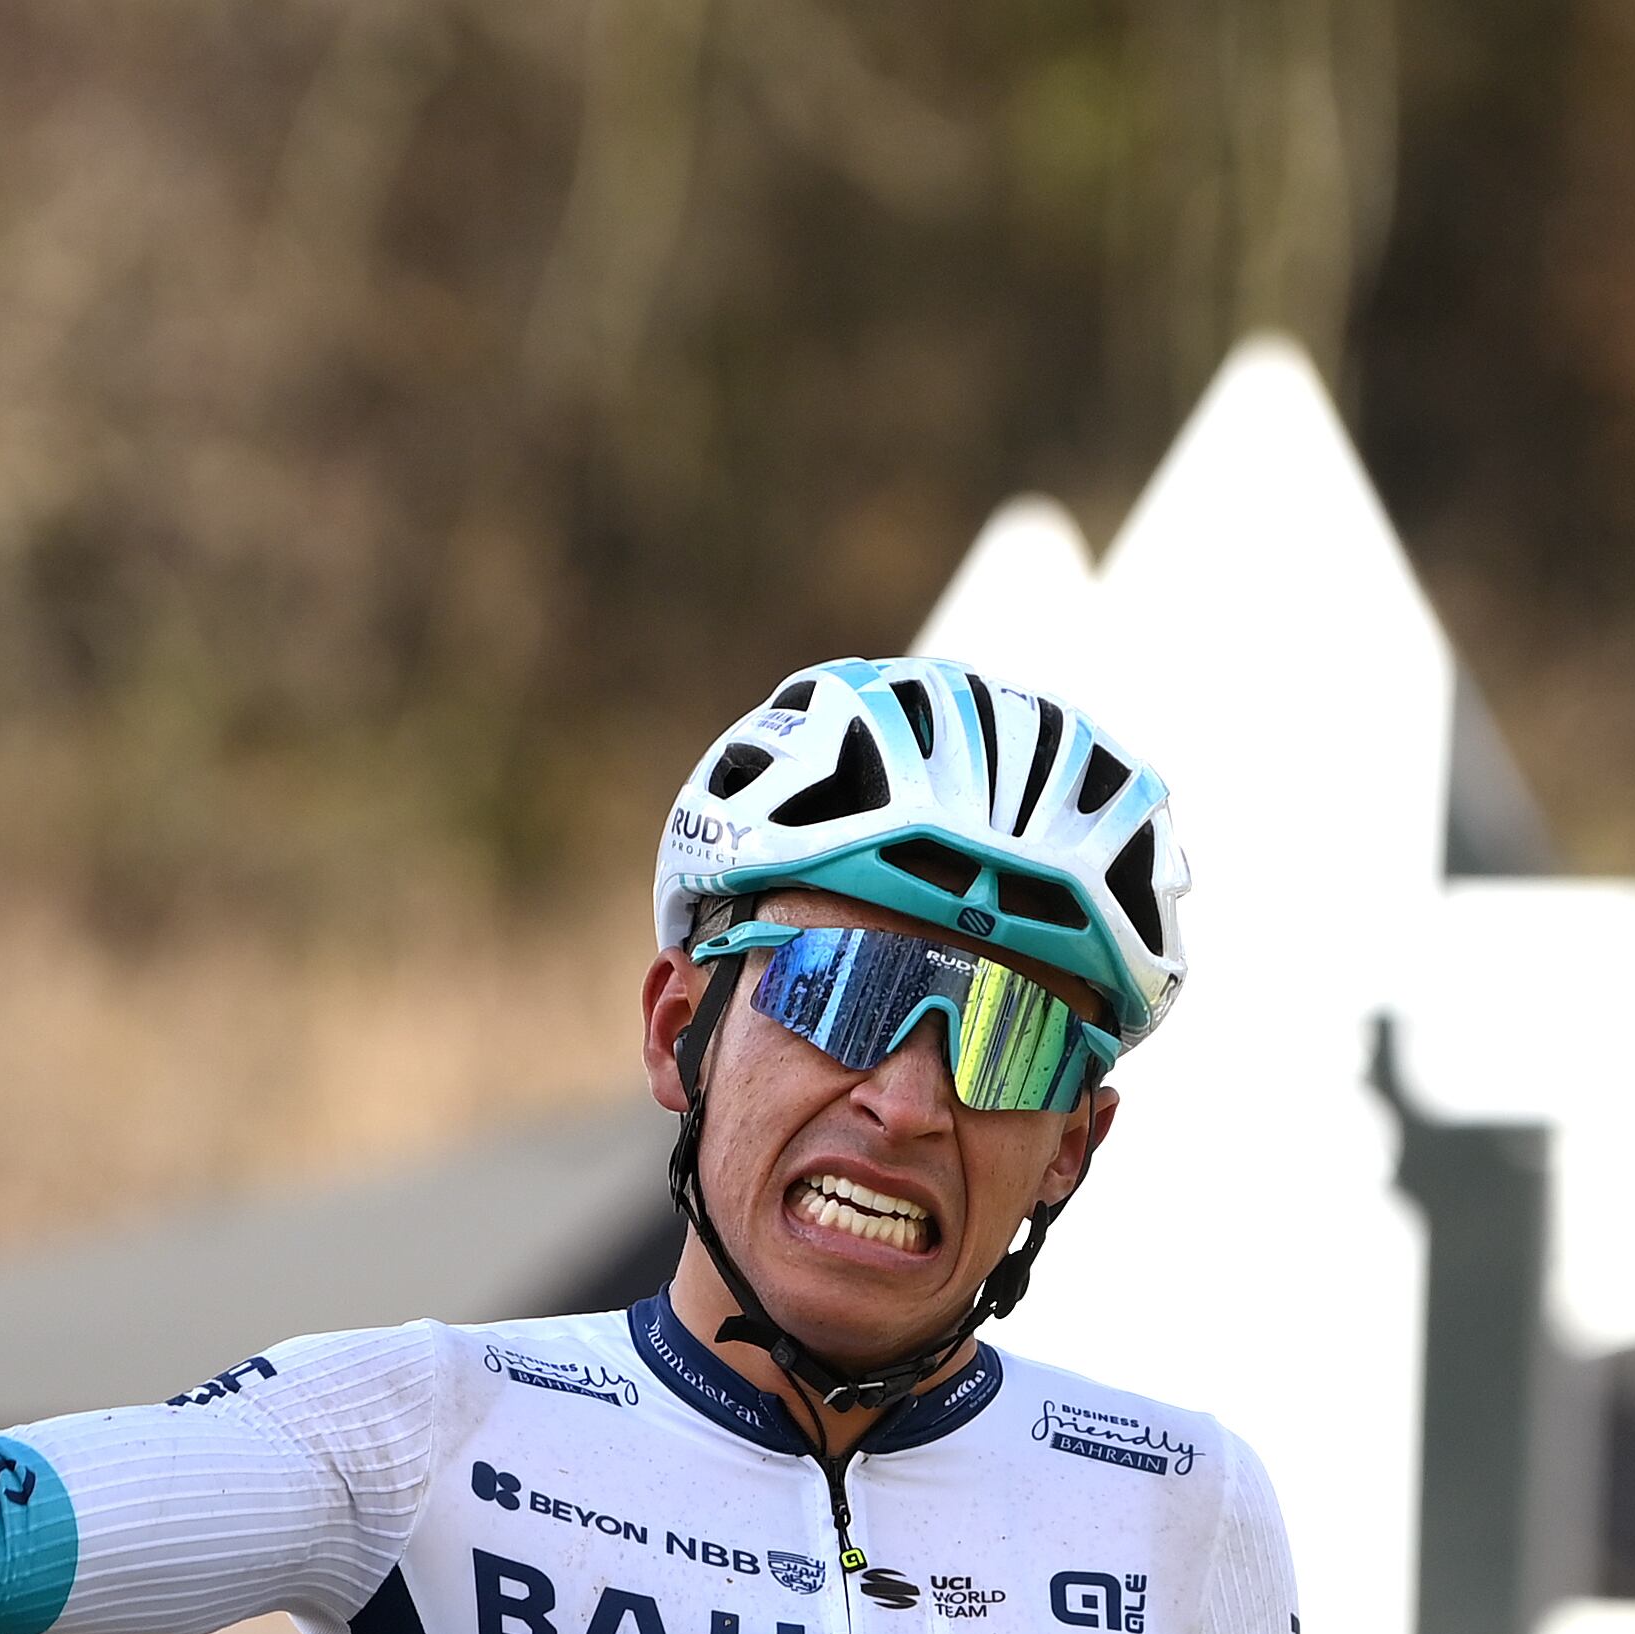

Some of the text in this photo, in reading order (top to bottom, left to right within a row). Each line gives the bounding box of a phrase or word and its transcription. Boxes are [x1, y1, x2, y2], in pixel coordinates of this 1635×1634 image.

[672, 807, 753, 851] RUDY
[671, 839, 737, 867] PROJECT
[926, 949, 984, 976] RUDY
[1061, 1403, 1140, 1429] BUSINESS
[1031, 1400, 1207, 1476] friendly
[1060, 1436, 1162, 1472] BAHRAIN
[529, 1490, 761, 1577] BEYON NBB
[930, 1574, 972, 1591] UCI
[931, 1589, 1007, 1604] WORLD
[934, 1603, 988, 1619] TEAM
